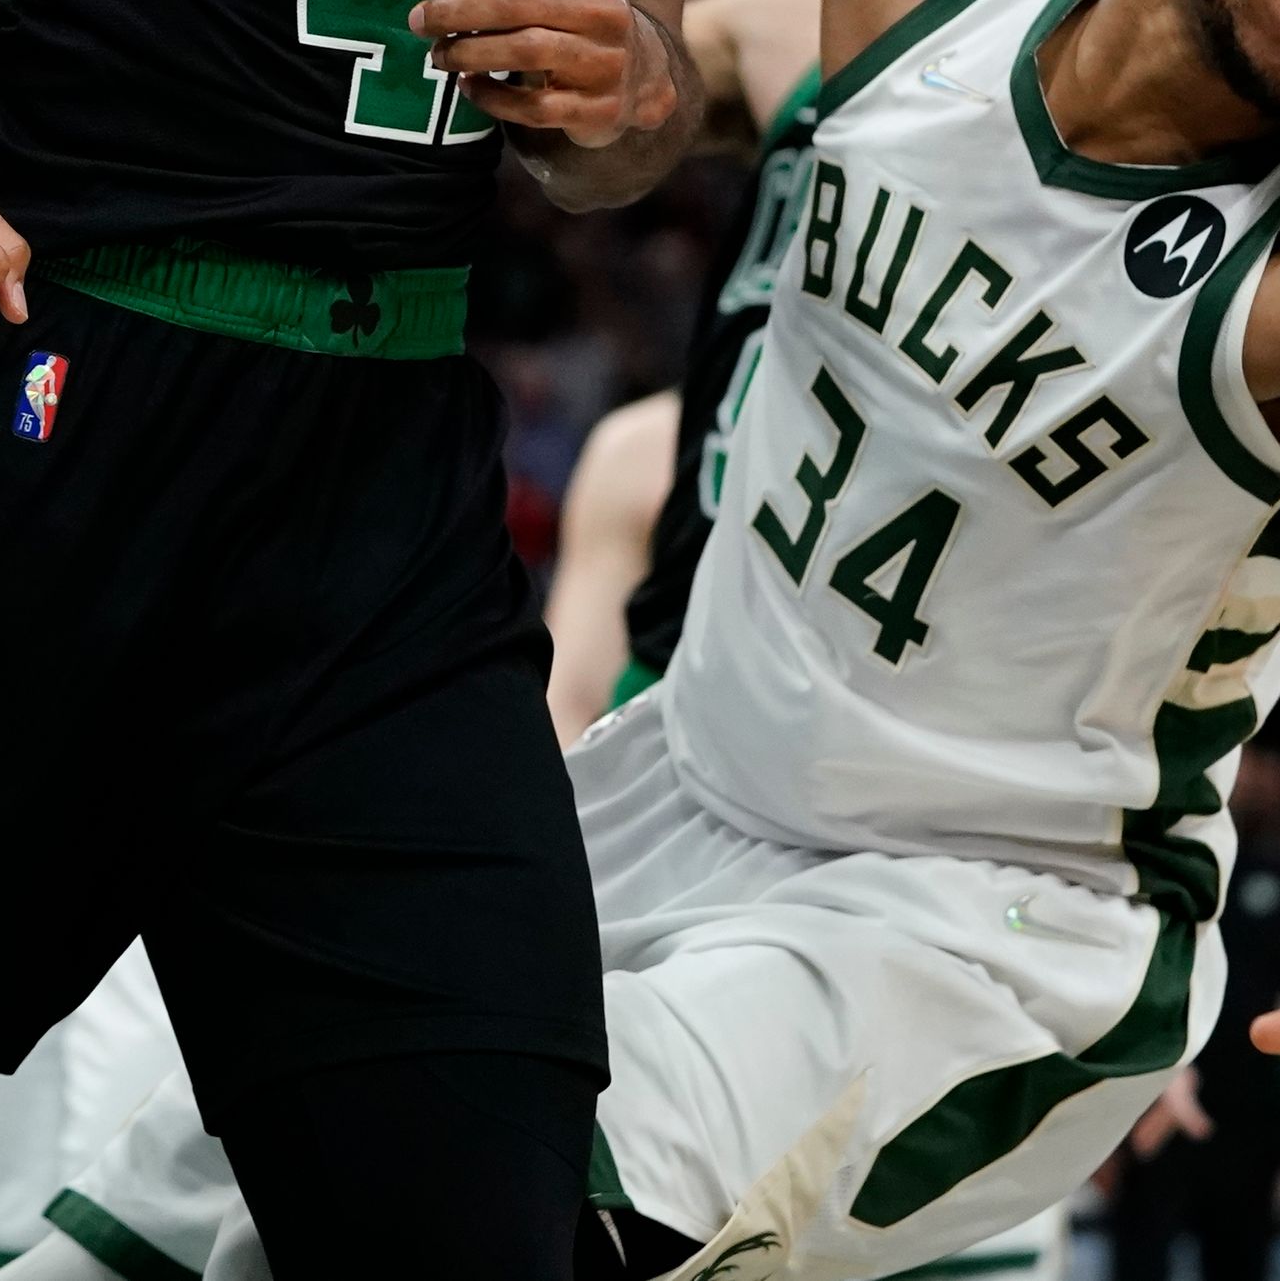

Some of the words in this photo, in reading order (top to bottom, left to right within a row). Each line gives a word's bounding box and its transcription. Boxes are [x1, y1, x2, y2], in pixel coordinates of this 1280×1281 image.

[19, 412, 34, 432] 75
[801, 158, 1153, 508] BUCKS
[750, 364, 963, 668] 34
